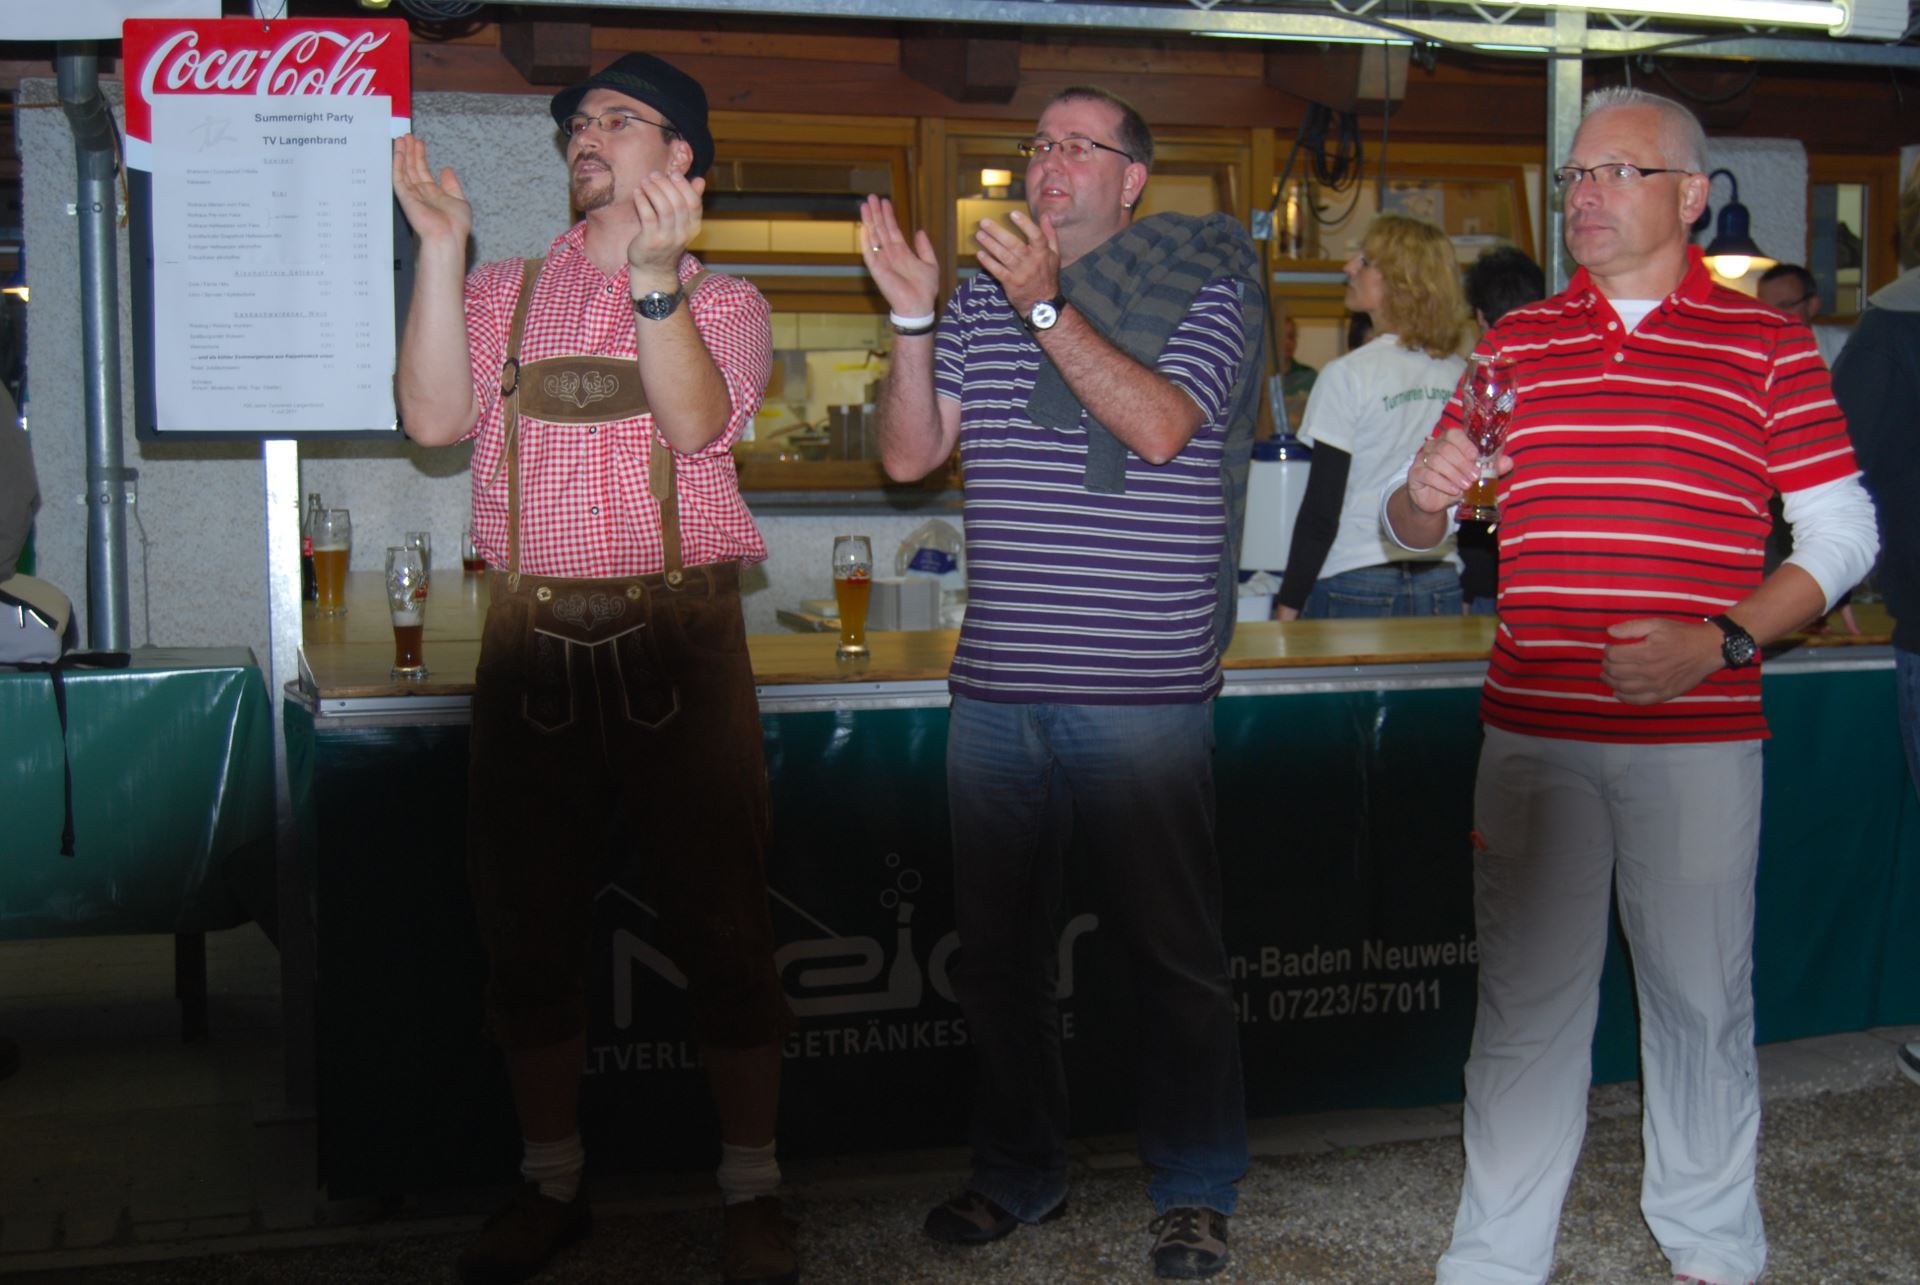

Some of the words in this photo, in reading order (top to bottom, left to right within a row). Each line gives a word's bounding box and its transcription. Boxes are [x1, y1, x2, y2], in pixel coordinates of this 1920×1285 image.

[140, 30, 391, 106] Coca-Cola
[254, 112, 324, 124] Summernight
[326, 112, 354, 125] Party
[262, 136, 277, 146] TV
[279, 136, 348, 148] Langenbrand
[1268, 978, 1442, 1022] 07223/57011
